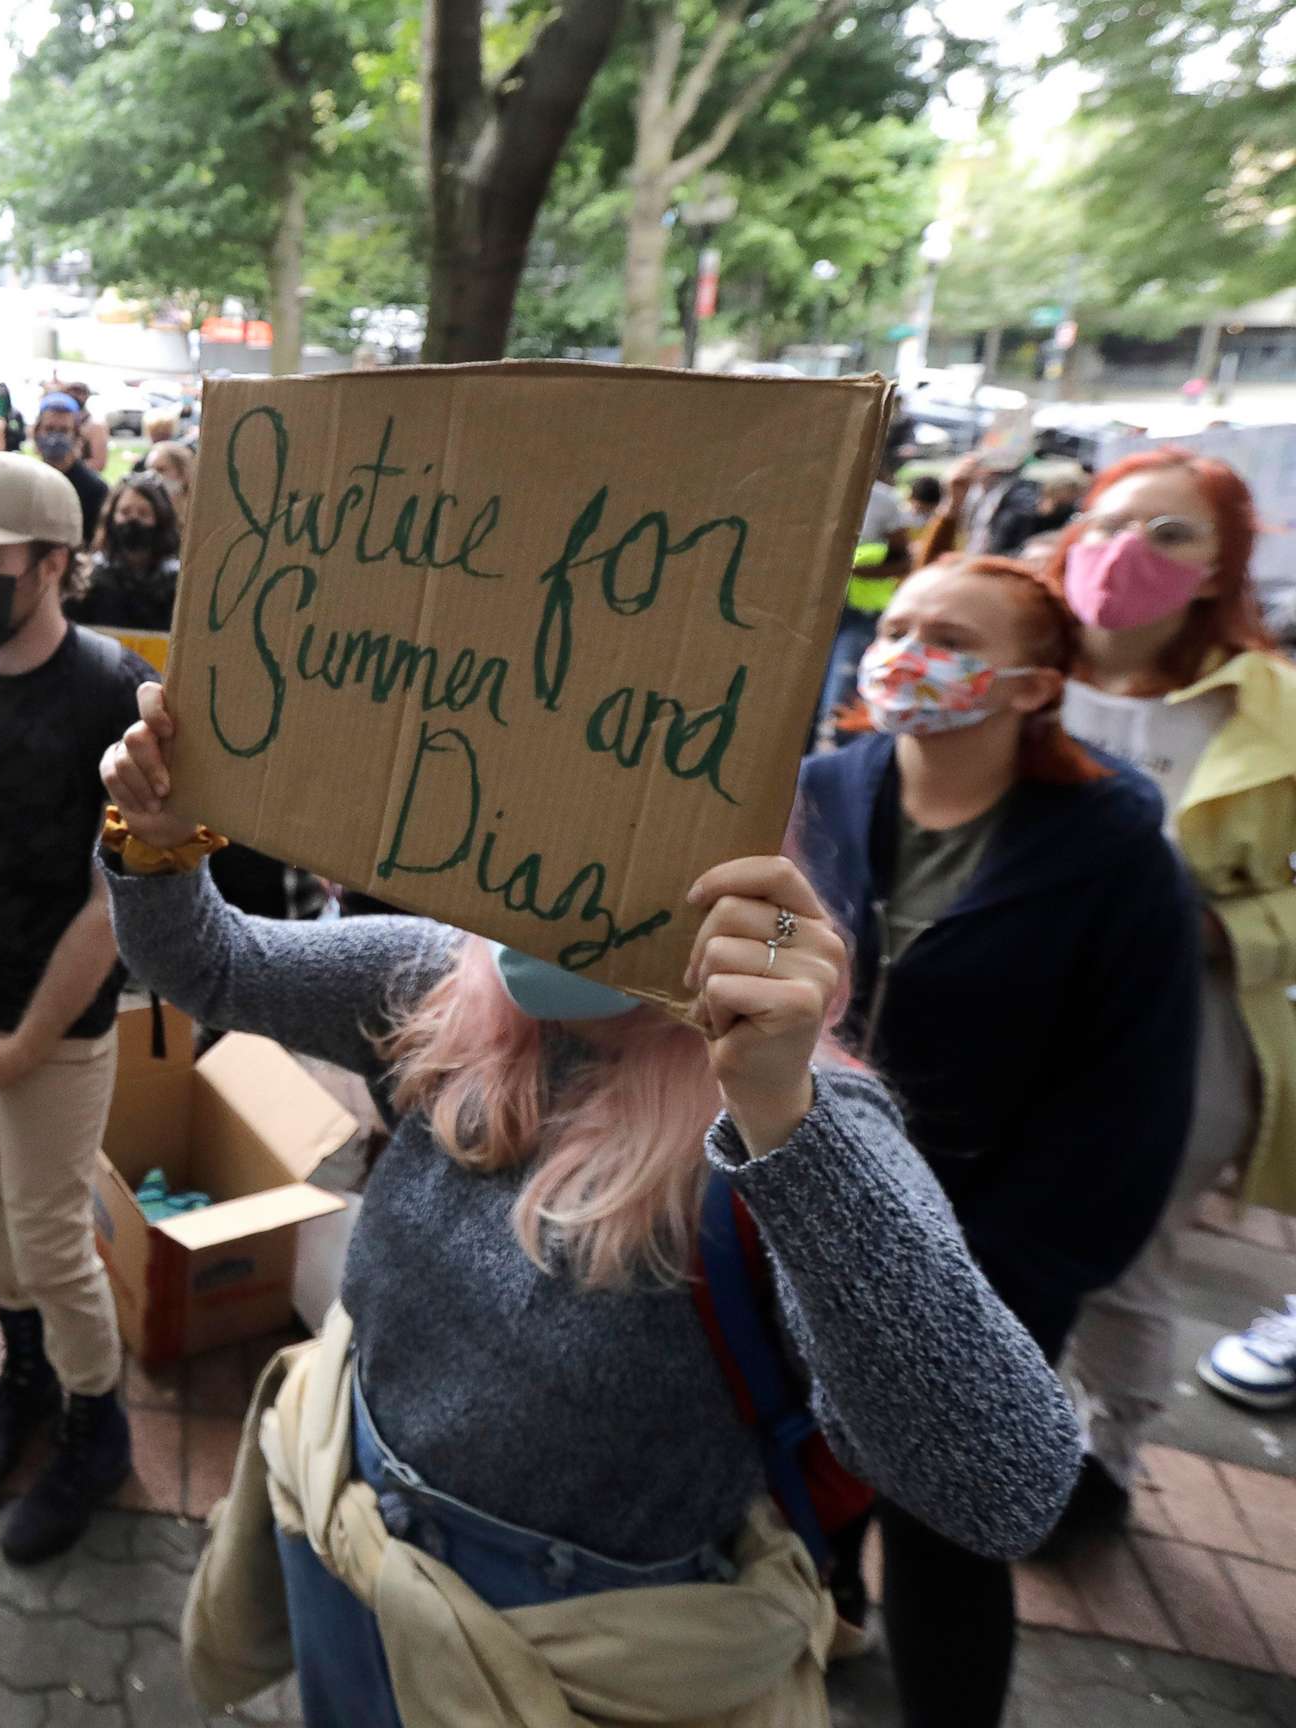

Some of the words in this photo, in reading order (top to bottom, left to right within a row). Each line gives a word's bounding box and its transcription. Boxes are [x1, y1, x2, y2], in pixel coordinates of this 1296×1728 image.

[207, 405, 504, 632] Justice
[534, 486, 756, 711] for
[208, 564, 509, 758] Summer
[586, 664, 748, 805] and
[378, 721, 671, 970] Diaz
